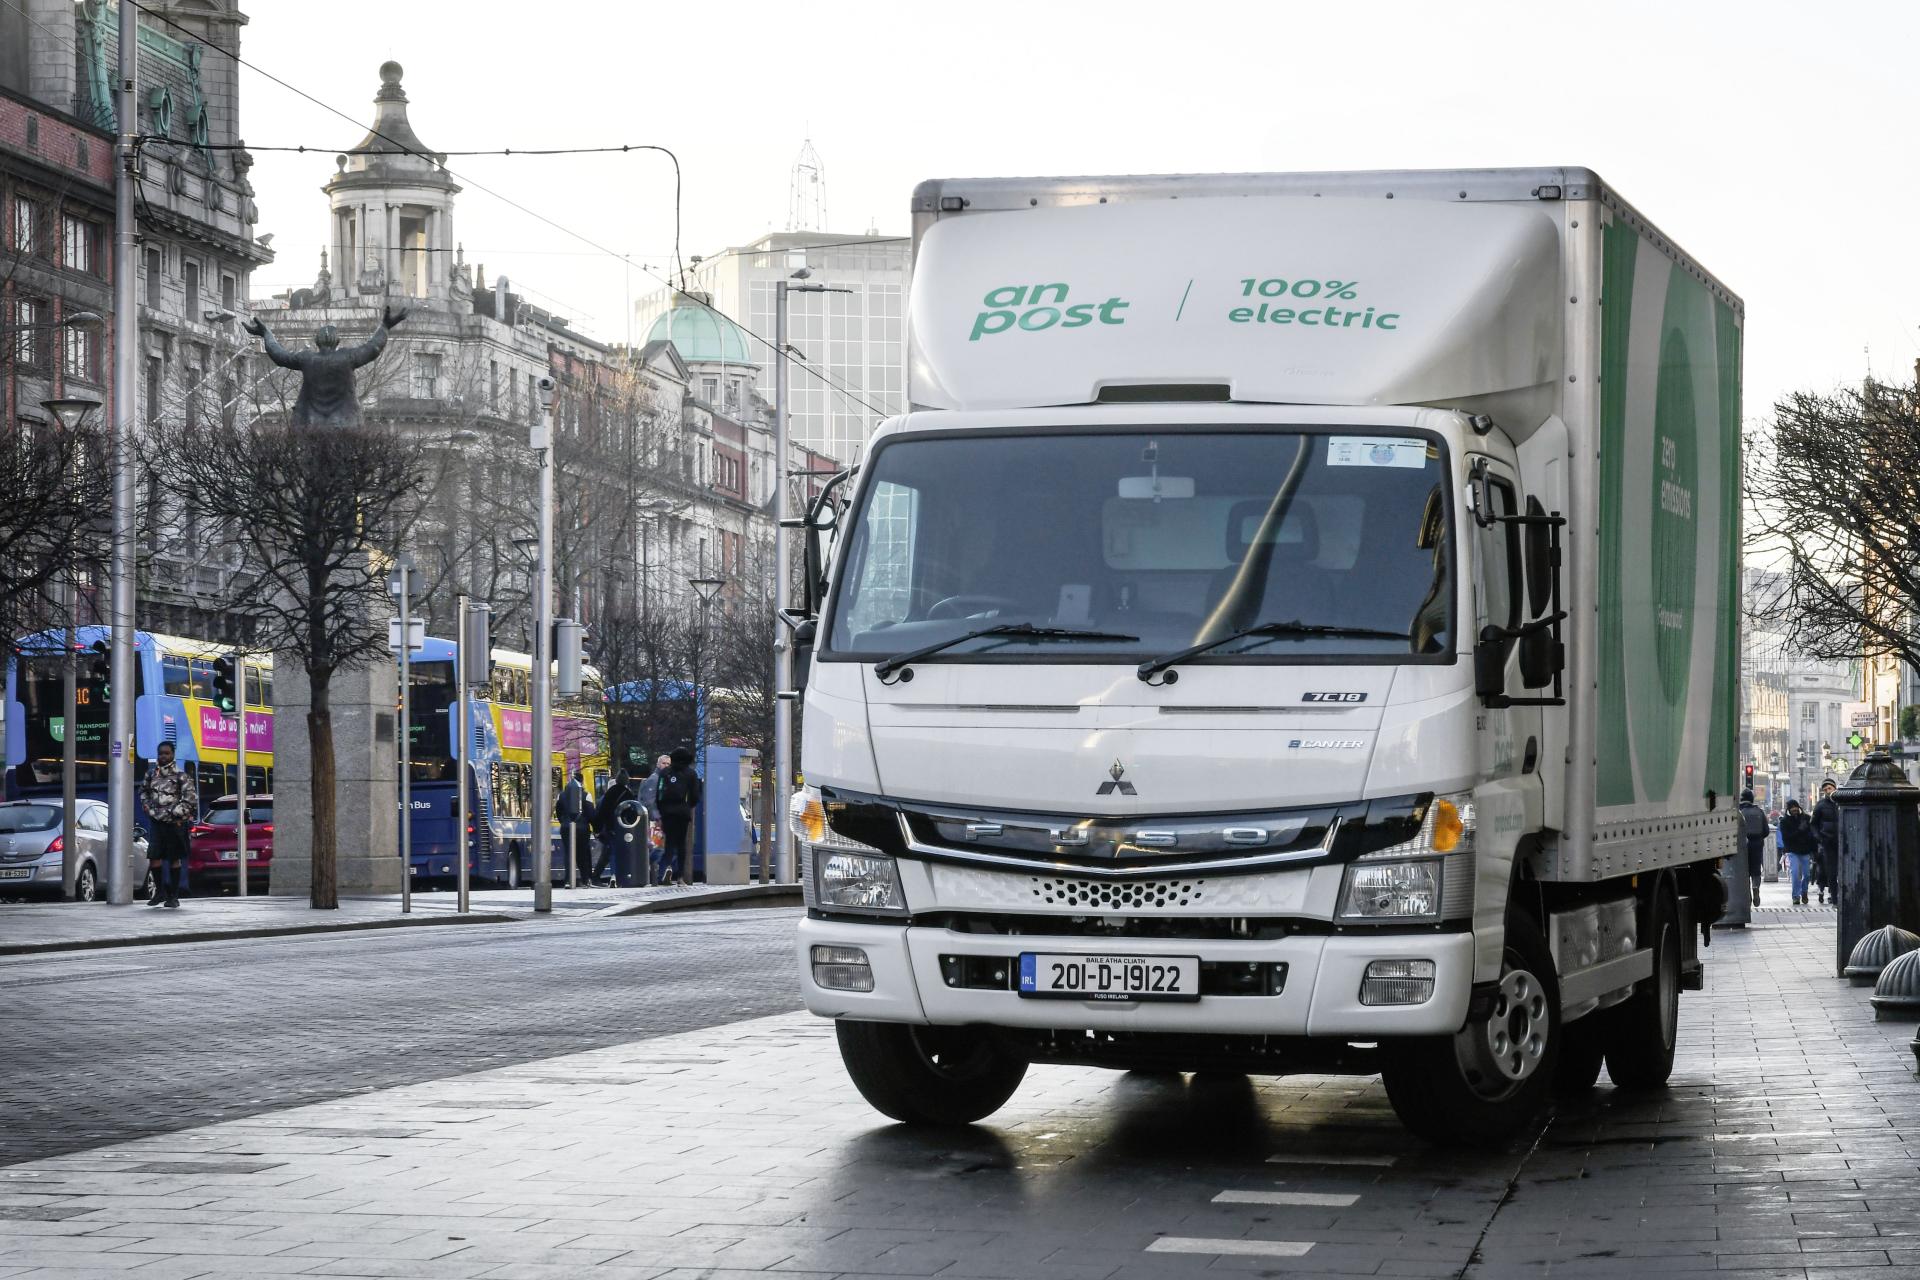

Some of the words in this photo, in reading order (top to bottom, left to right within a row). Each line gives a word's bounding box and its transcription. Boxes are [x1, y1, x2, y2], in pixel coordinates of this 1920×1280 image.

[984, 283, 1070, 308] an
[1240, 278, 1360, 300] 100%
[968, 297, 1130, 341] post
[1228, 303, 1401, 330] electric
[1661, 436, 1676, 470] zero
[1661, 474, 1691, 520] emissions
[1311, 693, 1361, 701] 7C18
[53, 725, 64, 734] TF
[228, 720, 248, 734] wos
[414, 801, 431, 809] Bus
[966, 823, 1270, 848] FUSO
[1022, 976, 1034, 985] IRL
[1051, 963, 1181, 992] 201-D-19122
